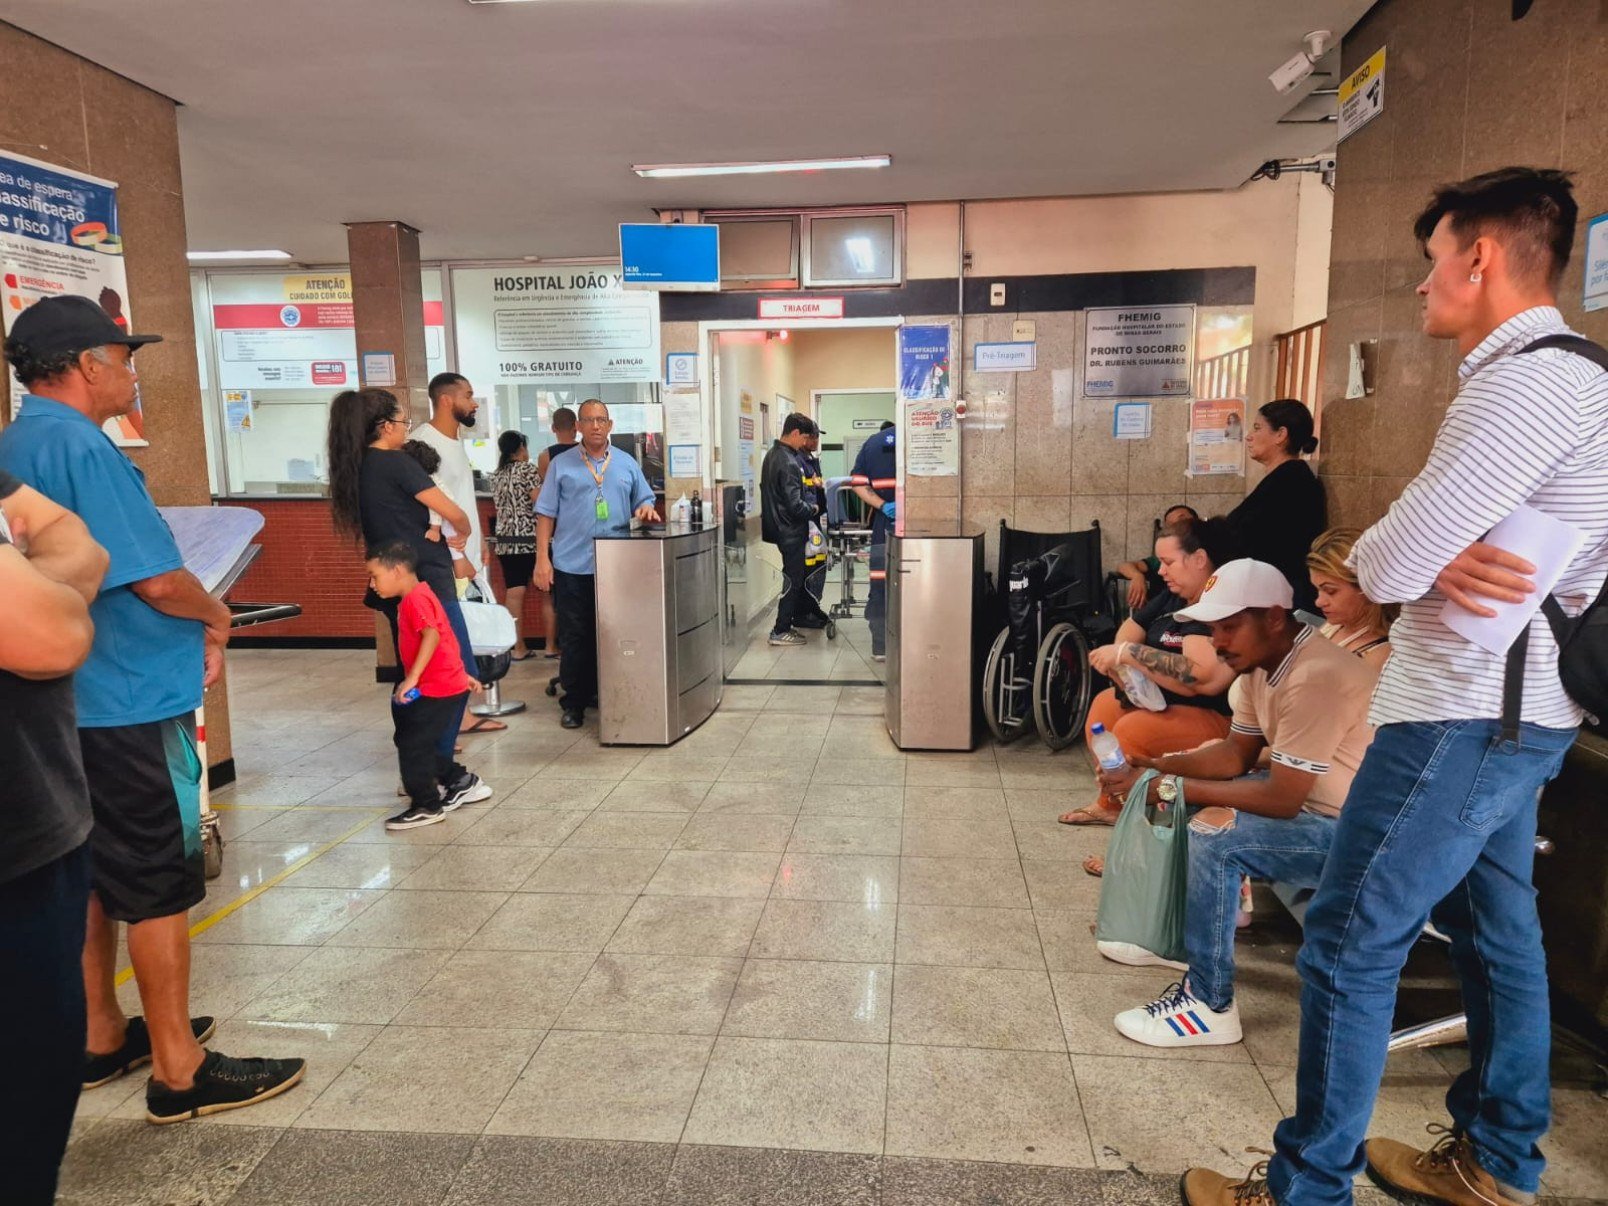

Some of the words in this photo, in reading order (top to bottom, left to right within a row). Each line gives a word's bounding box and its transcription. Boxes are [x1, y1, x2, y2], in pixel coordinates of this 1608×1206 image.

[1351, 65, 1370, 90] AVISO
[17, 175, 31, 190] de
[34, 182, 72, 200] espera
[13, 214, 50, 236] risco
[19, 275, 64, 291] EMERGÊNCIA
[306, 278, 345, 291] ATENÇÃO
[494, 275, 564, 291] HOSPITAL
[569, 271, 608, 290] JOÃO
[289, 292, 319, 300] CUIDADO
[320, 292, 336, 300] COM
[560, 293, 590, 302] Emergência
[783, 304, 820, 312] TRIAGEM
[1118, 313, 1161, 322] FHEMIG
[1090, 346, 1133, 355] PRONTO
[1136, 344, 1187, 354] SOCORRO
[982, 351, 1026, 360] Pré-Triagem
[499, 362, 527, 372] 100%
[530, 361, 583, 372] GRATUITO
[615, 358, 643, 366] ATENÇÃO
[1105, 359, 1137, 367] RUBENS
[1138, 357, 1186, 366] GUIMARÃES
